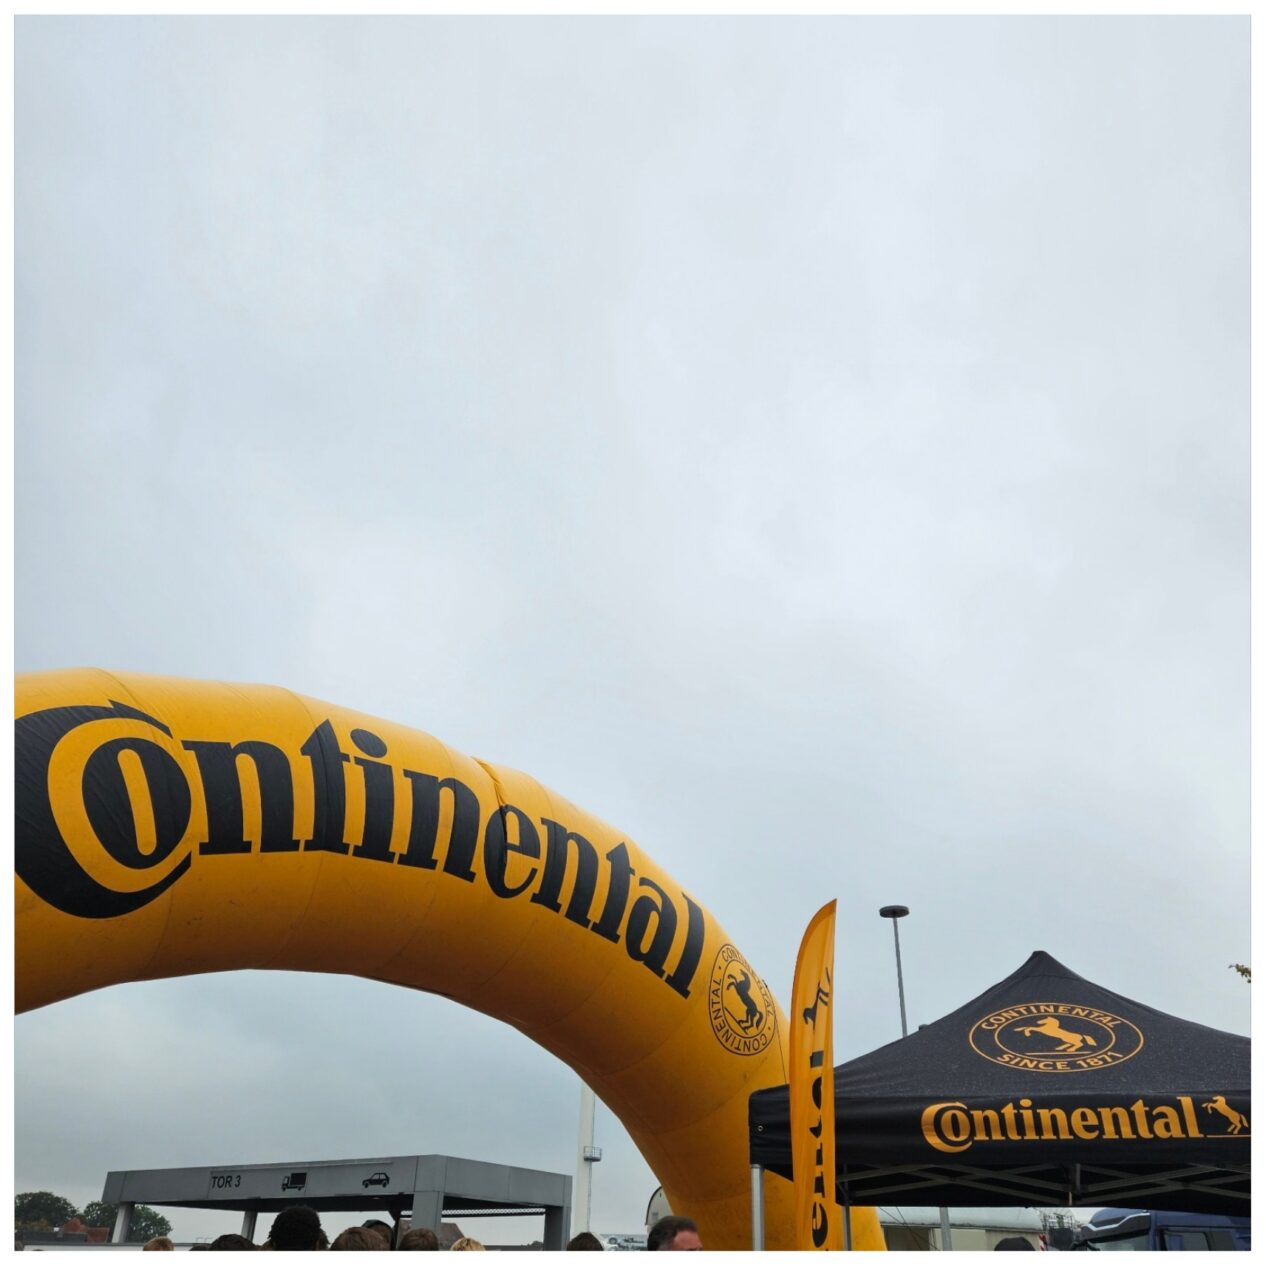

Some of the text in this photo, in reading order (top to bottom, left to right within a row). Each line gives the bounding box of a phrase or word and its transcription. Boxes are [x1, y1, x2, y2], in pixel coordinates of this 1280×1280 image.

[14, 700, 706, 999] Continental
[980, 1004, 1123, 1030] CONTINENTAL
[997, 1050, 1124, 1071] SINCE 1871
[921, 1096, 1205, 1153] Continental
[211, 1175, 241, 1189] TOR 3
